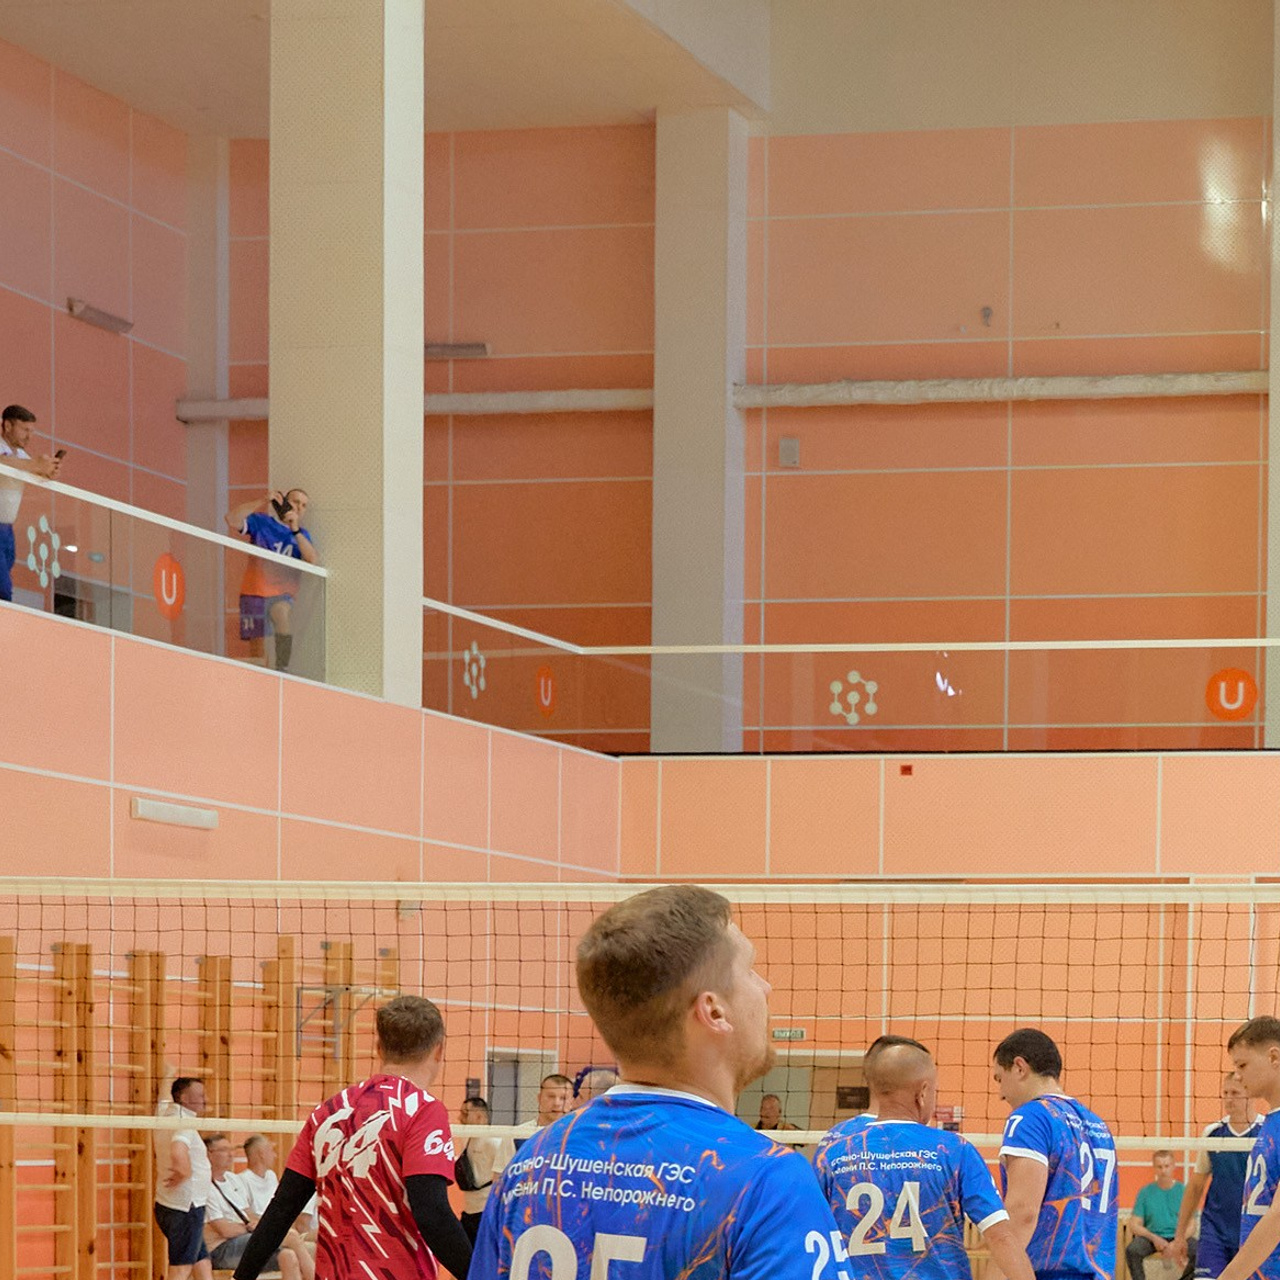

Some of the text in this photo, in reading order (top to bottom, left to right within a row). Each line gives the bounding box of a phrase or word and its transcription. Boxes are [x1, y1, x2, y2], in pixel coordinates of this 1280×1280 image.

[162, 569, 177, 605] U
[541, 677, 552, 706] U
[1220, 681, 1245, 710] U
[313, 1108, 393, 1179] 64
[919, 1149, 938, 1160] ГЭС
[657, 1162, 696, 1184] ГЭС
[1080, 1142, 1116, 1214] 27
[541, 1177, 577, 1199] П.С.
[581, 1182, 696, 1213] Непорожнего
[845, 1180, 929, 1257] 24
